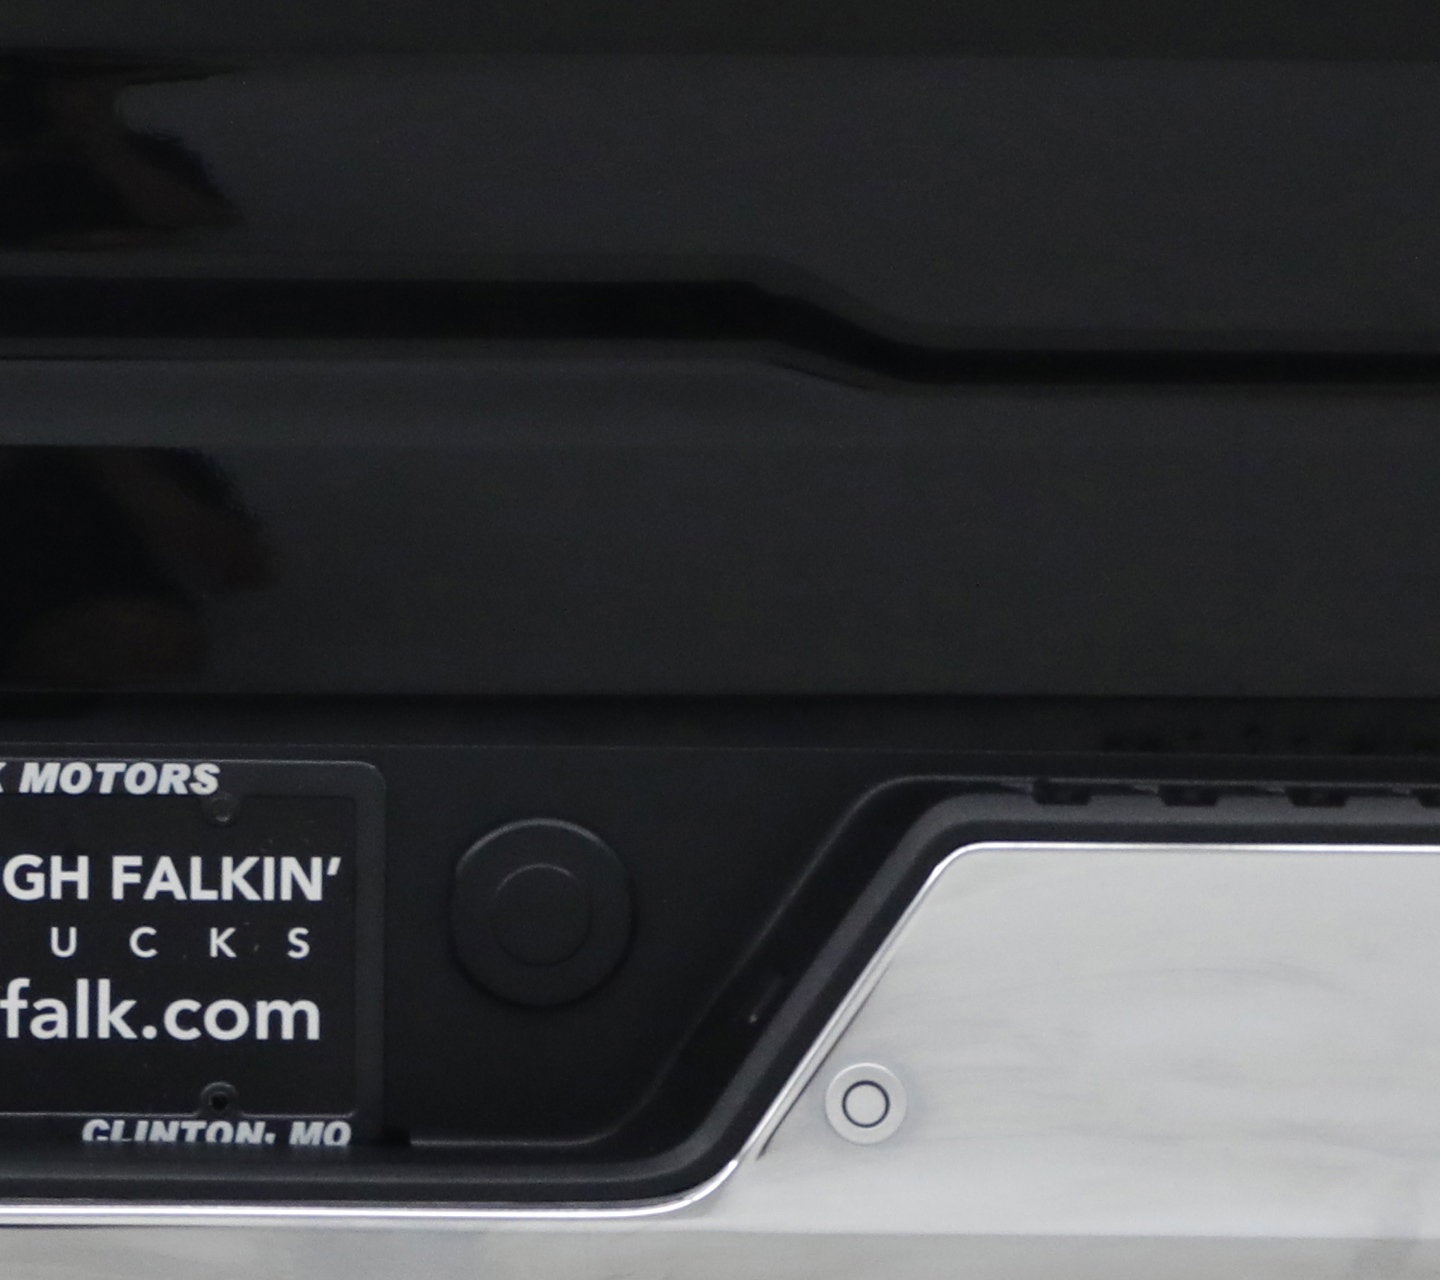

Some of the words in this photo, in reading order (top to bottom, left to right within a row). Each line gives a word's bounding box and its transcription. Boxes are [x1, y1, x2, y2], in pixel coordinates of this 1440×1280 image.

[18, 761, 220, 795] MOTORS
[111, 855, 341, 902] FALKIN'
[289, 1120, 351, 1146] MO
